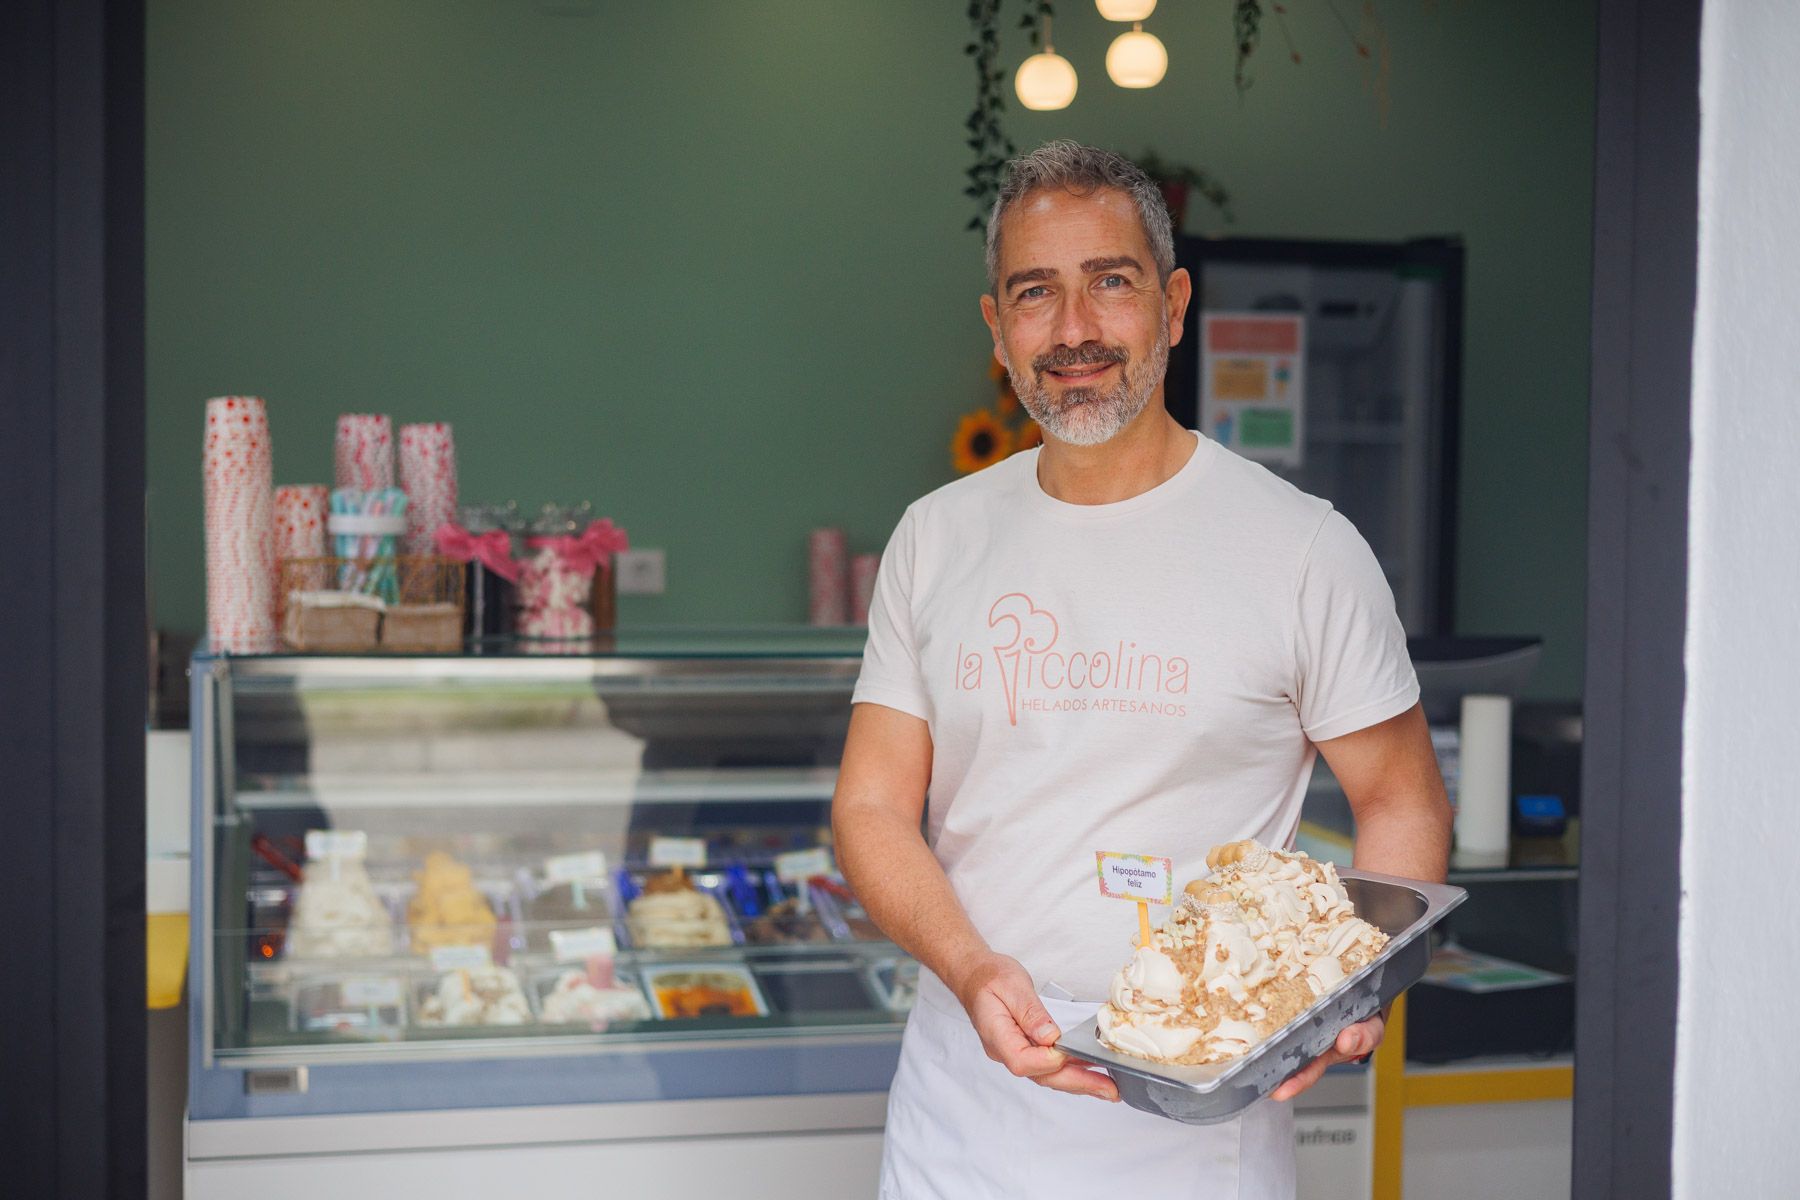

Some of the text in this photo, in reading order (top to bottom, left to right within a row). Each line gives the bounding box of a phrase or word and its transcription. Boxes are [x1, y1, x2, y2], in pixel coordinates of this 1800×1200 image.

[955, 642, 984, 691] la
[1021, 698, 1187, 718] HELADOS ARTESANOS
[1112, 865, 1157, 879] Hipopótamo
[1127, 878, 1143, 889] feliz
